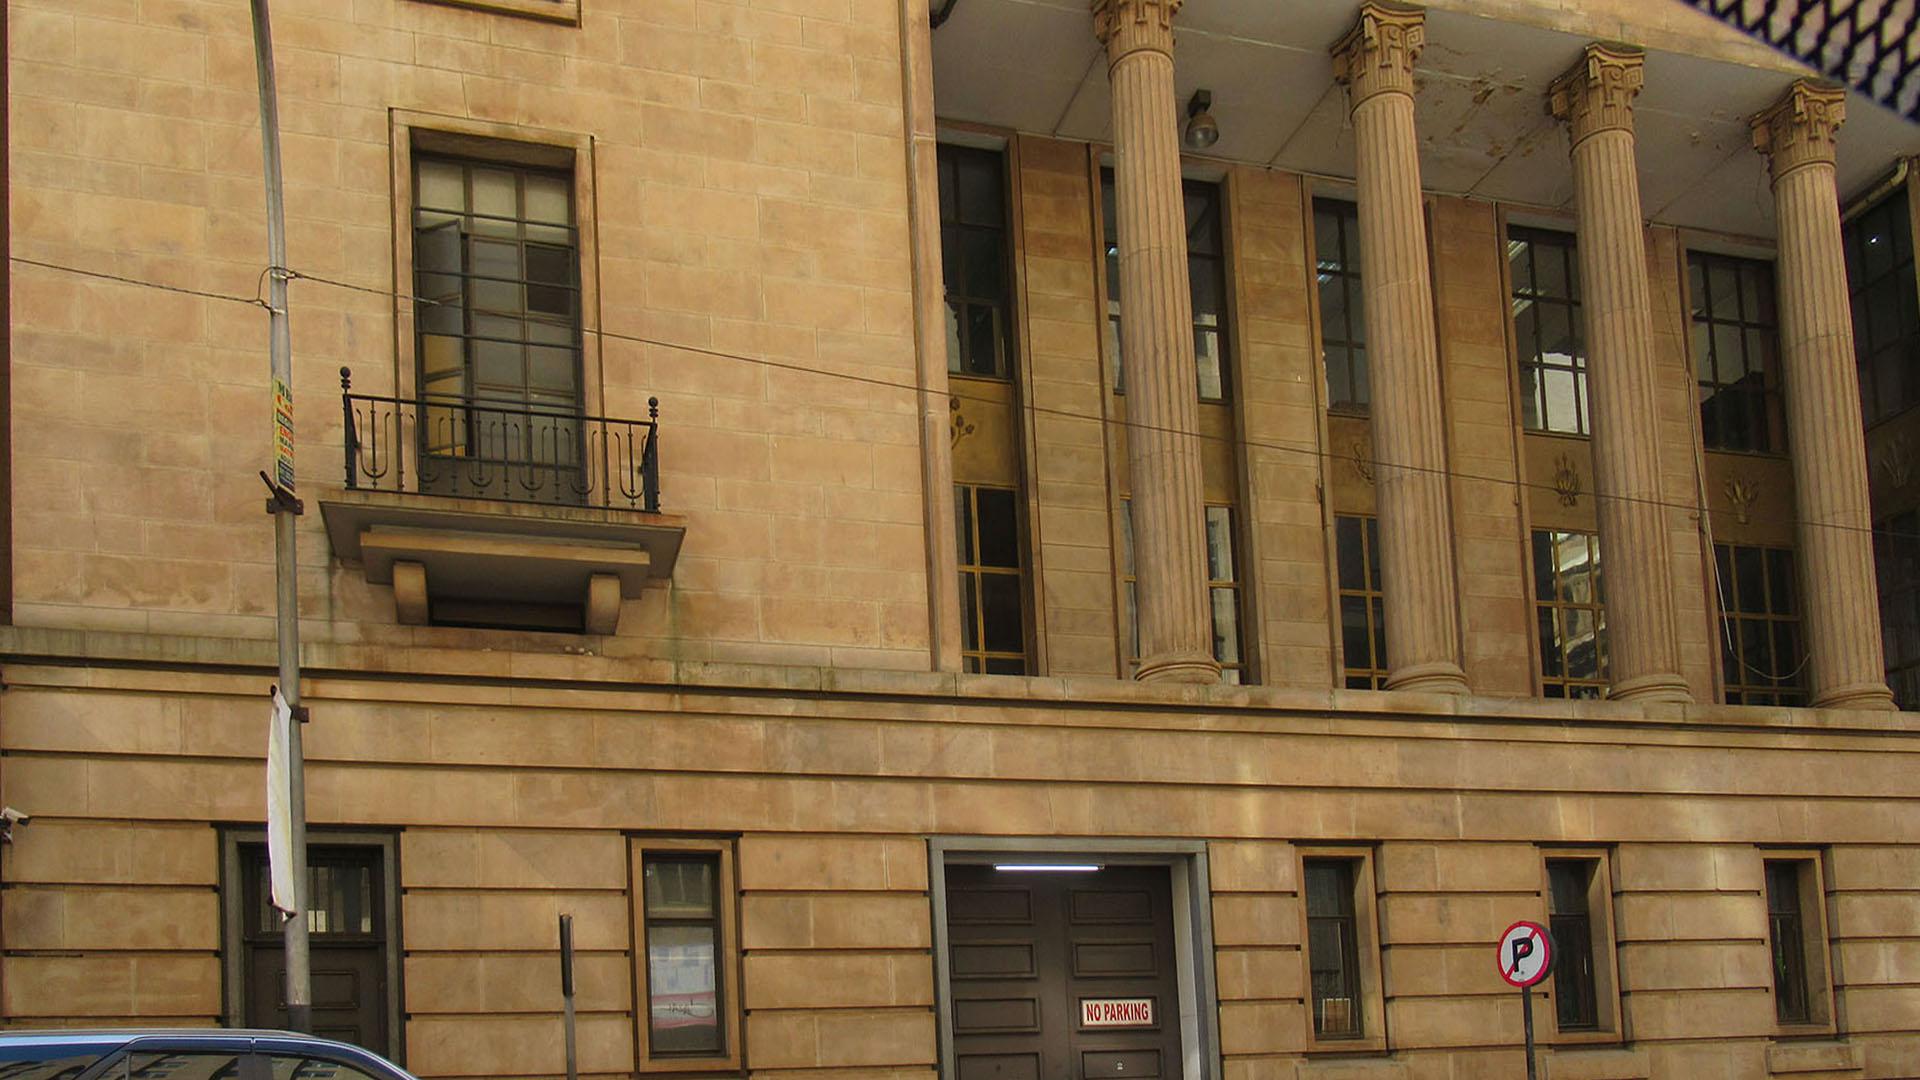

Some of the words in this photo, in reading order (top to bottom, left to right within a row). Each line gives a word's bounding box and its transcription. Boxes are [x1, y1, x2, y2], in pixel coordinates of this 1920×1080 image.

[1512, 937, 1534, 972] P
[1086, 1003, 1101, 1021] NO
[1104, 1002, 1149, 1021] PARKING
